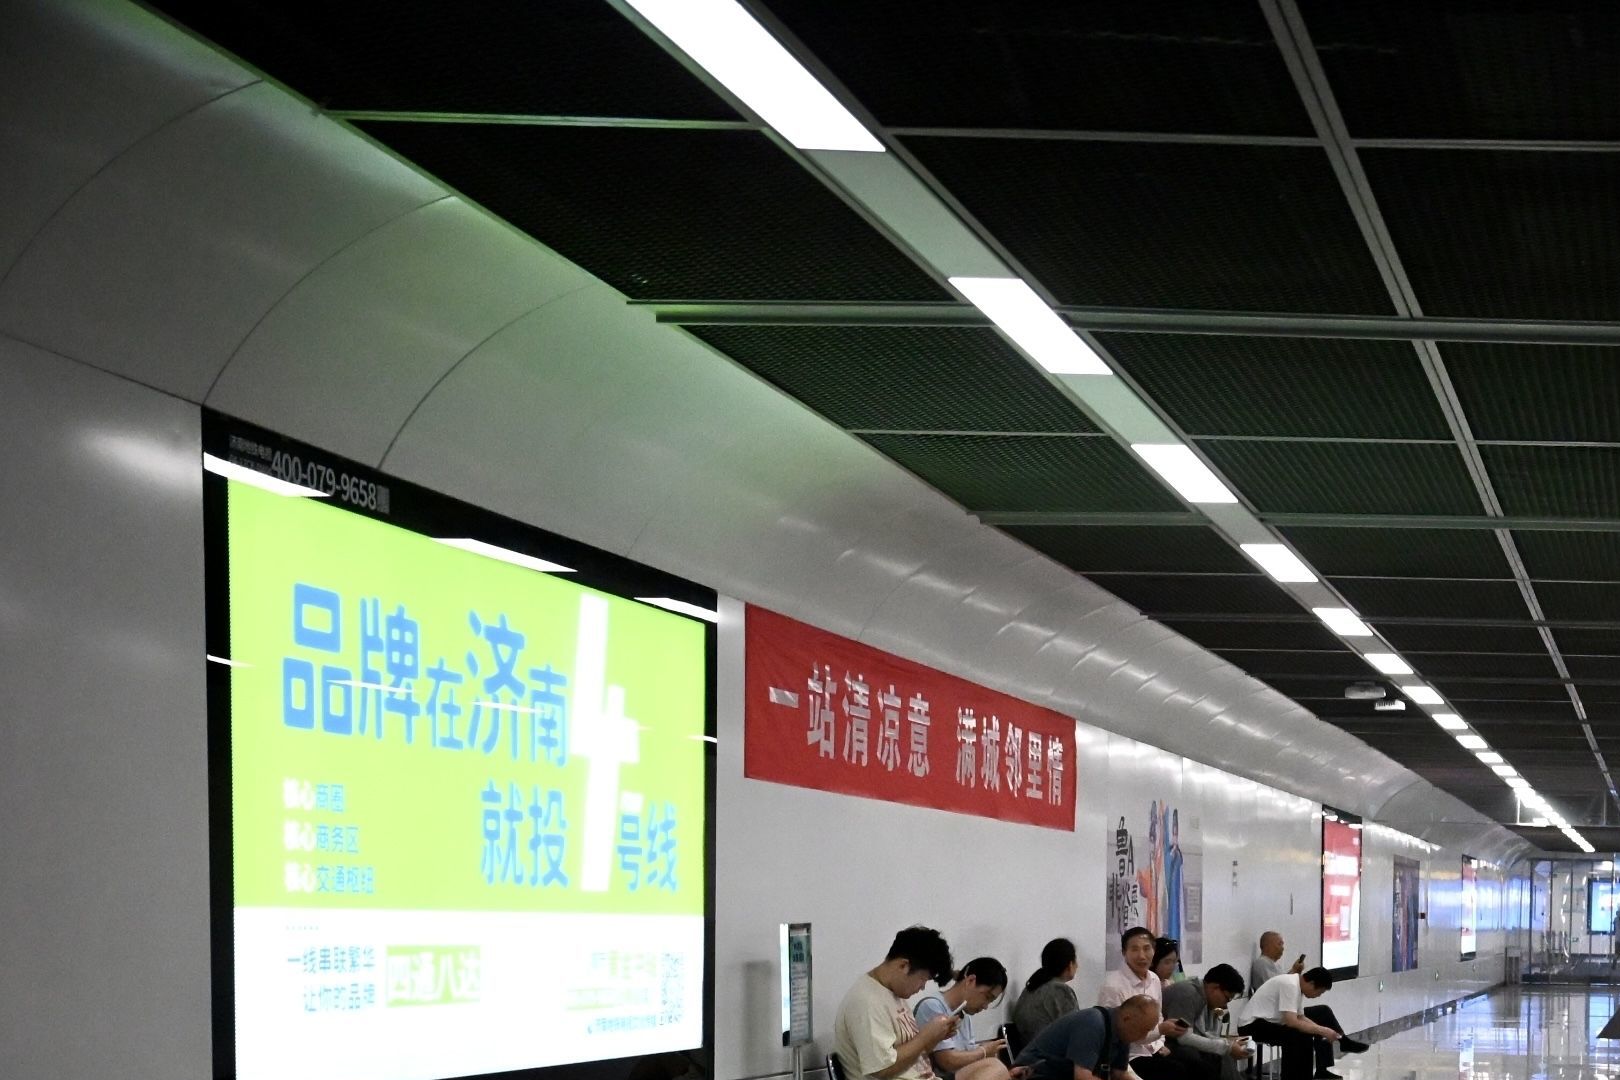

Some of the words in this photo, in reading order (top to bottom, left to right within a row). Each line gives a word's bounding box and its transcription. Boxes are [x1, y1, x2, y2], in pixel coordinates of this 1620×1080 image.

[271, 451, 377, 511] 400-079-9658
[282, 582, 568, 767] 品牌在济南
[768, 661, 931, 777] 一站清凉意
[955, 705, 1064, 806] 满城邻里情
